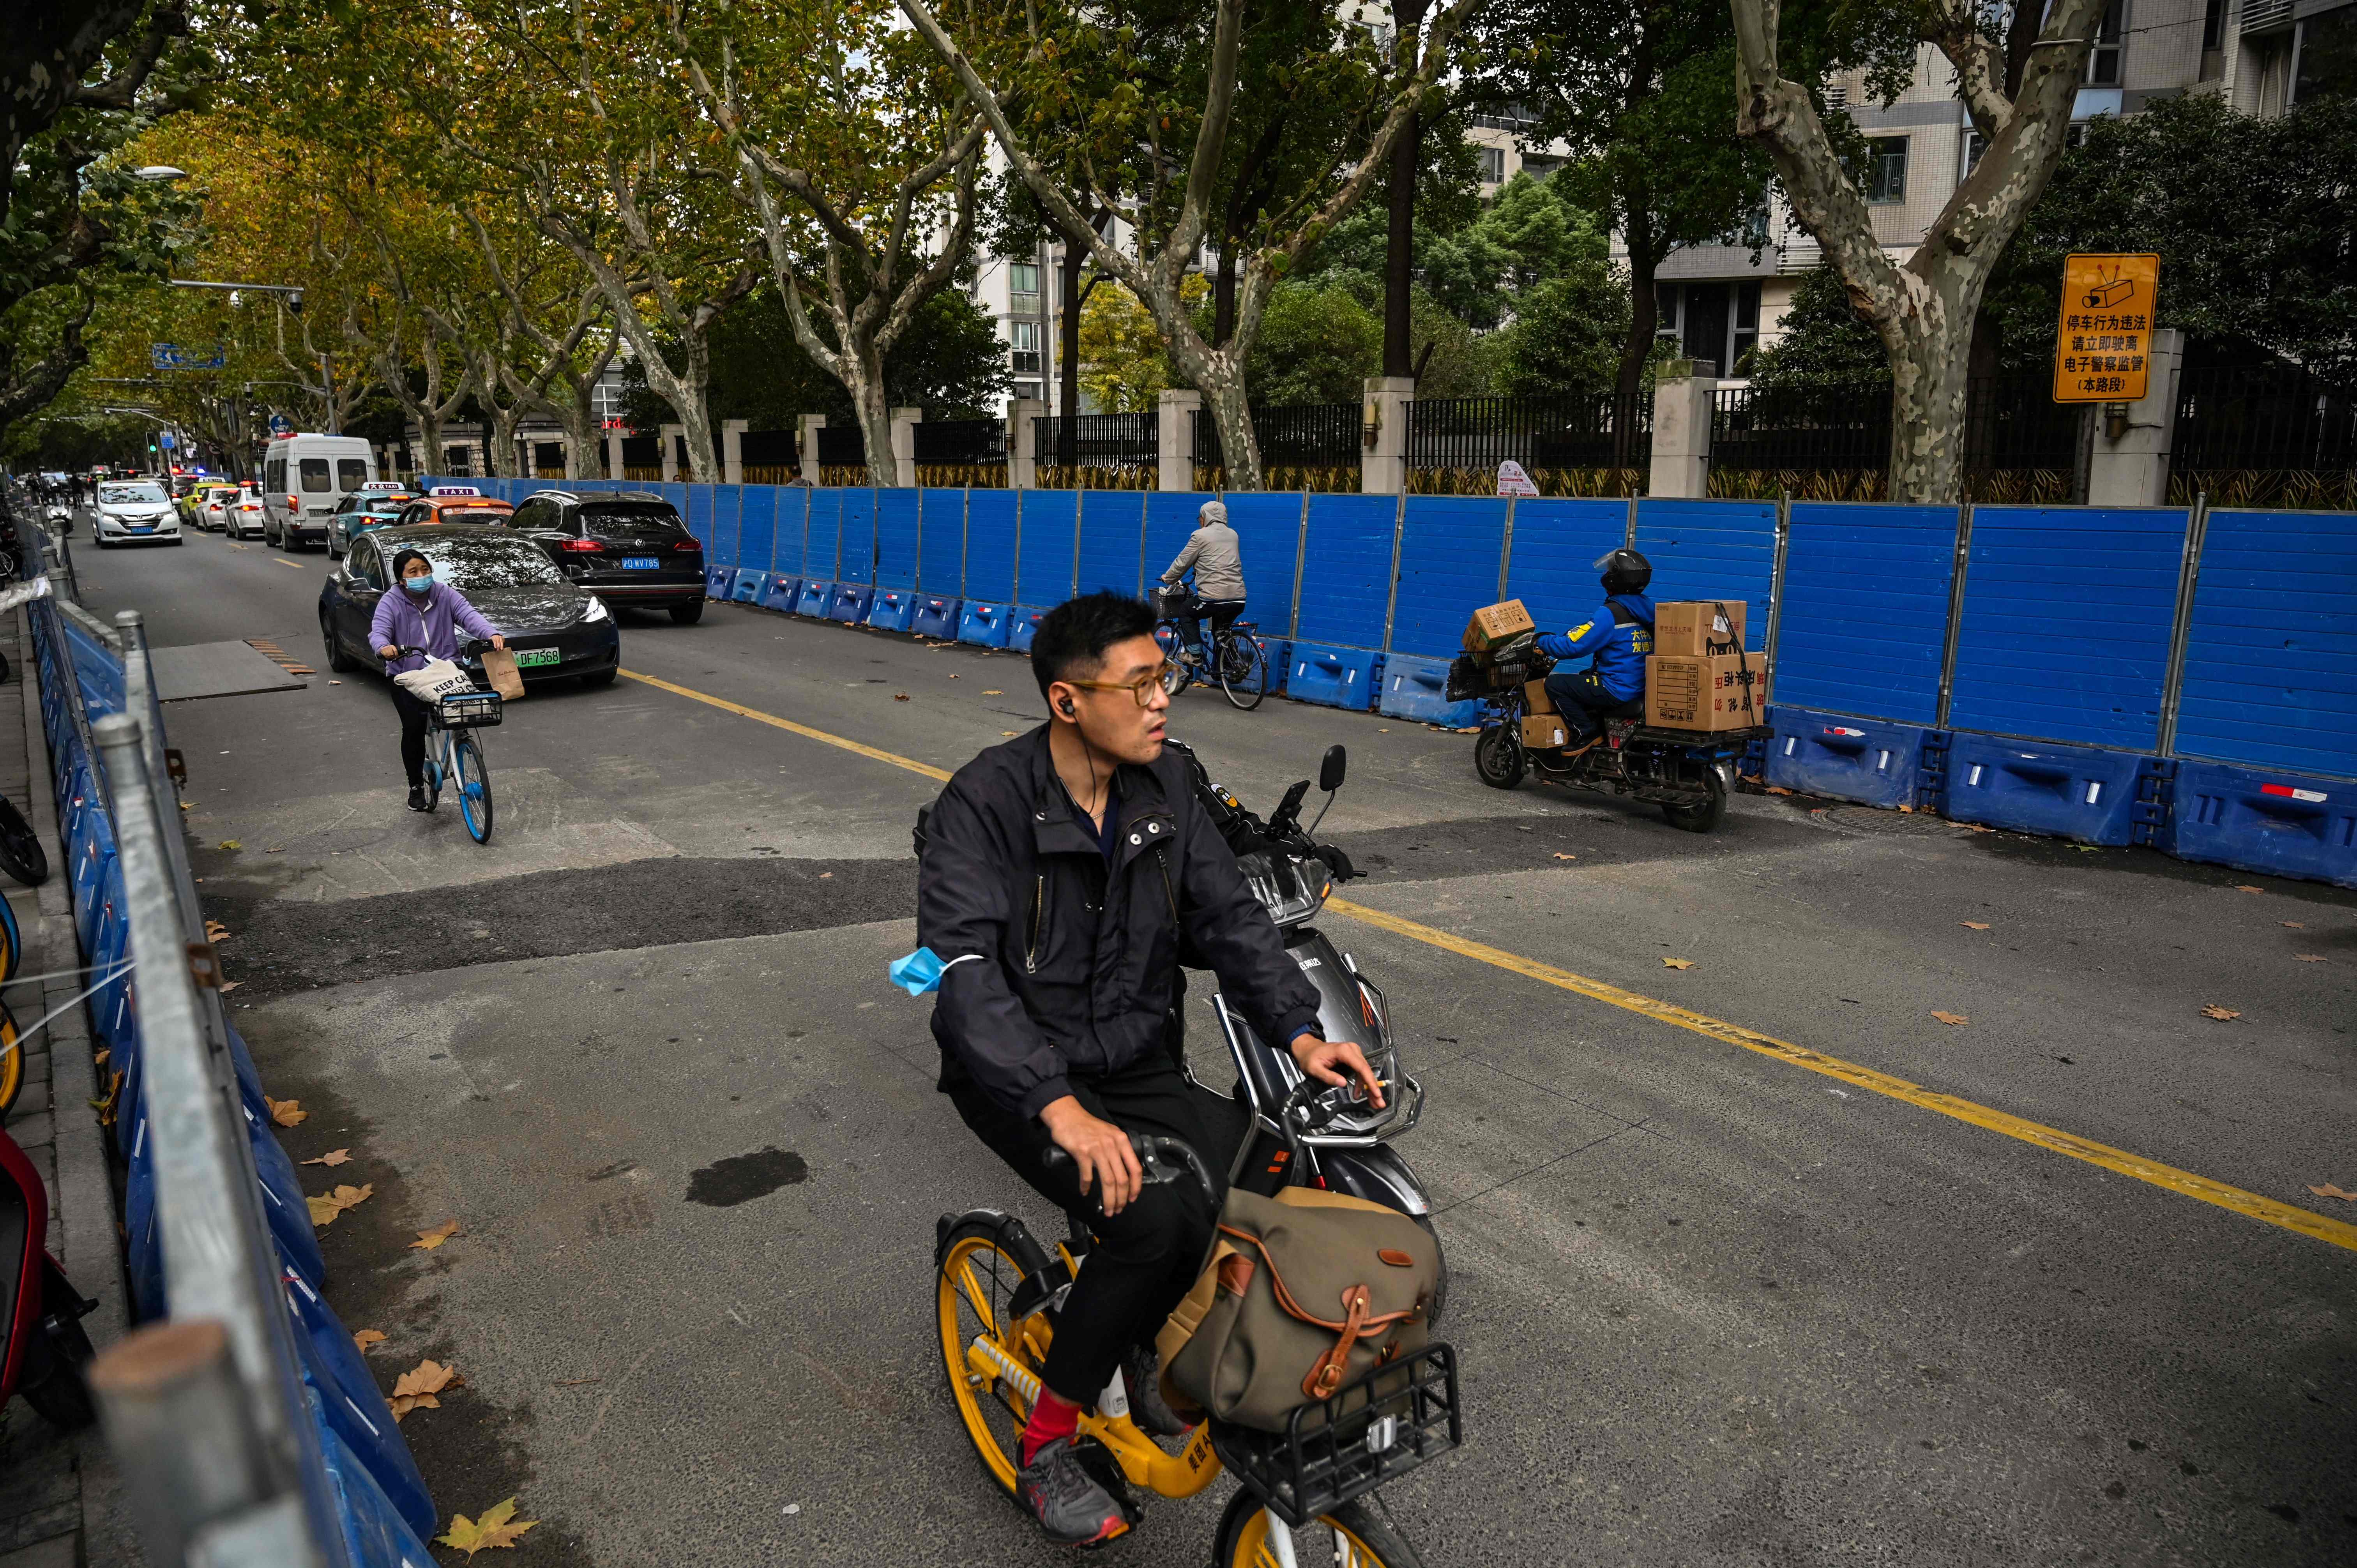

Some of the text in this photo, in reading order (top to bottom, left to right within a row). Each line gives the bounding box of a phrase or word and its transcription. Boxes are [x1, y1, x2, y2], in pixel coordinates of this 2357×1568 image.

[2067, 314, 2146, 331] 停车行为违法
[2072, 335, 2138, 352] 请立即驶离
[2064, 355, 2144, 373] 电子警察监管
[1631, 629, 1651, 641] 大件
[1632, 642, 1653, 653] 发德
[433, 680, 454, 693] KEEP
